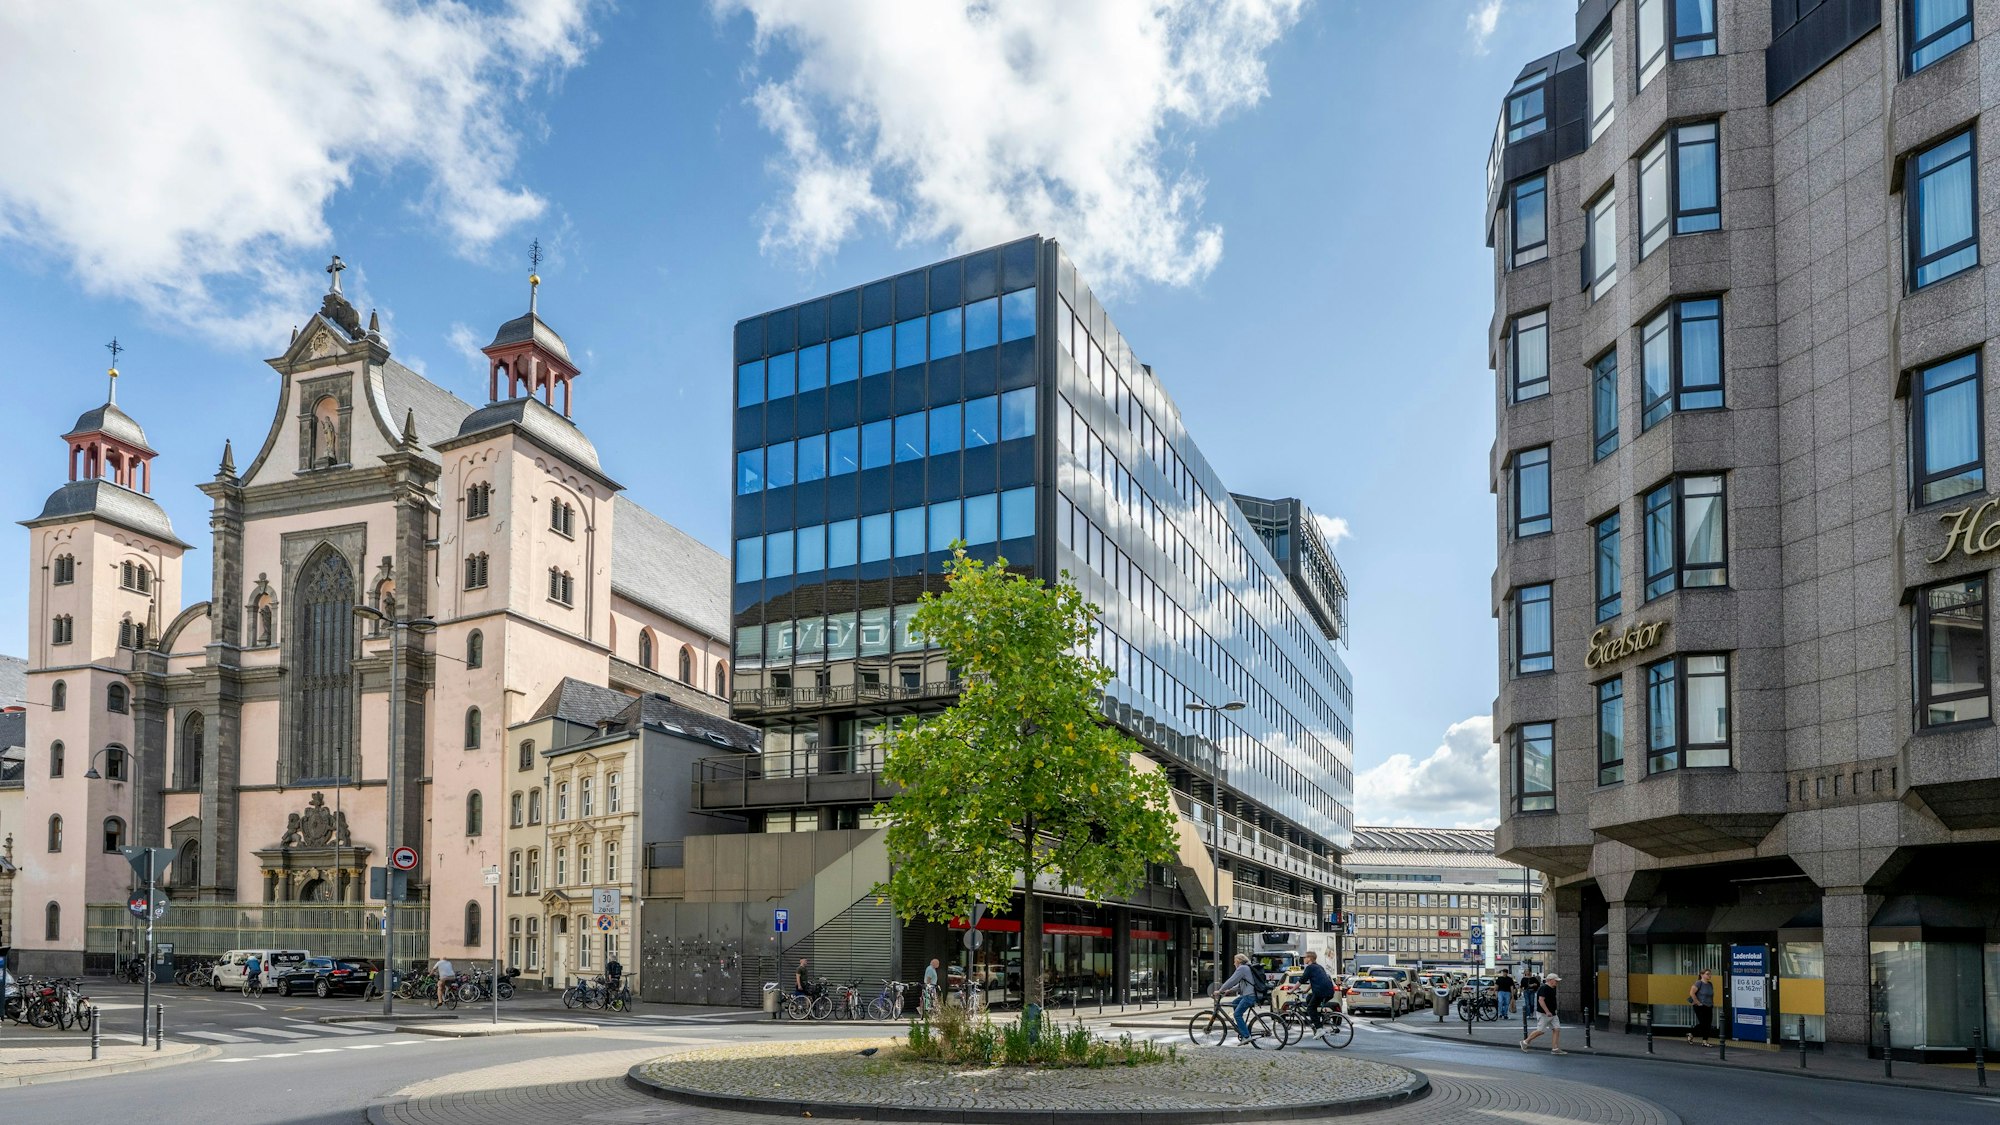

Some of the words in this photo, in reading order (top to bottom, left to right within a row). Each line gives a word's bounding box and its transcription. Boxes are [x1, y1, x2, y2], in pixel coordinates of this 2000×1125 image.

[1584, 620, 1667, 669] Excelsior
[602, 894, 612, 903] 30
[1733, 952, 1762, 960] Ladenlokal
